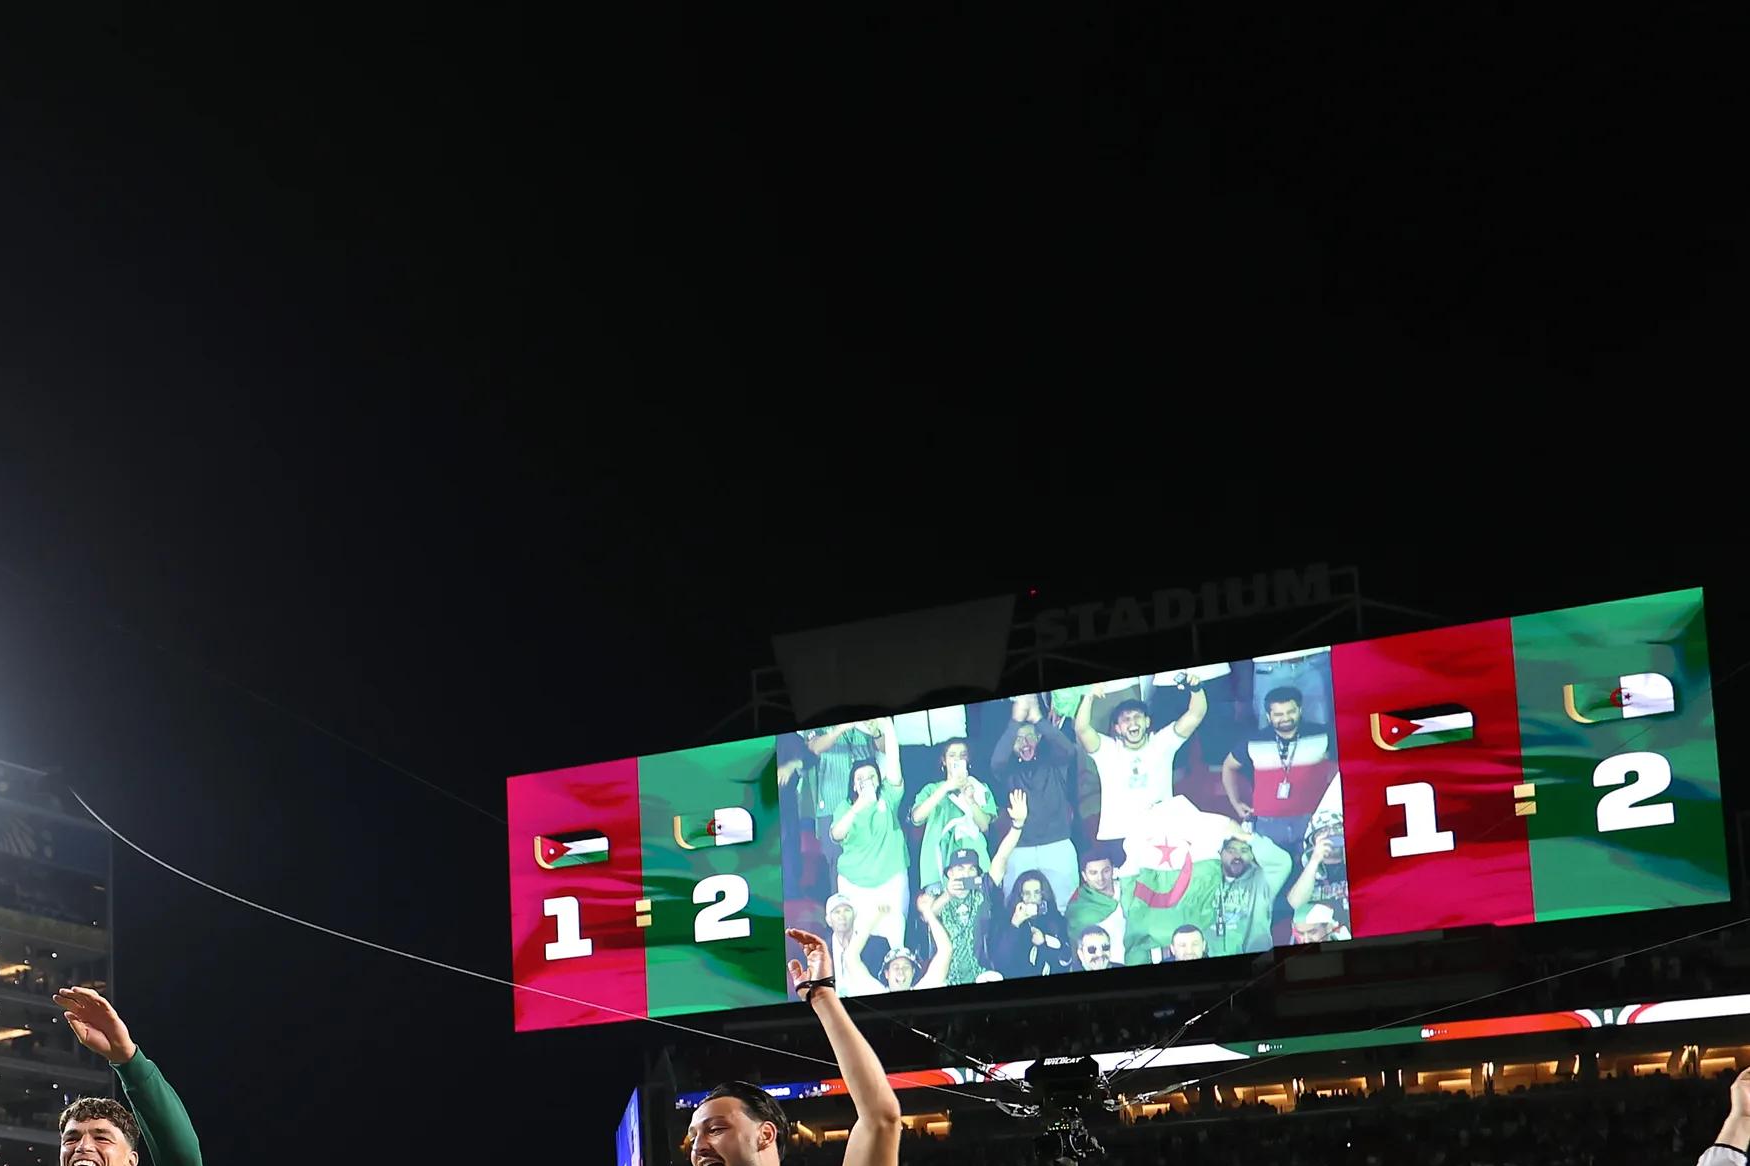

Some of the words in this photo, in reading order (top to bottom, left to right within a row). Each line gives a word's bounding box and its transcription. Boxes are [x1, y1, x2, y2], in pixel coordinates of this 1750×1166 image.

[1035, 564, 1331, 647] STADIUM
[1386, 782, 1455, 858] 1
[1593, 752, 1675, 832] 2
[543, 896, 592, 960] 1
[692, 874, 750, 942] 2
